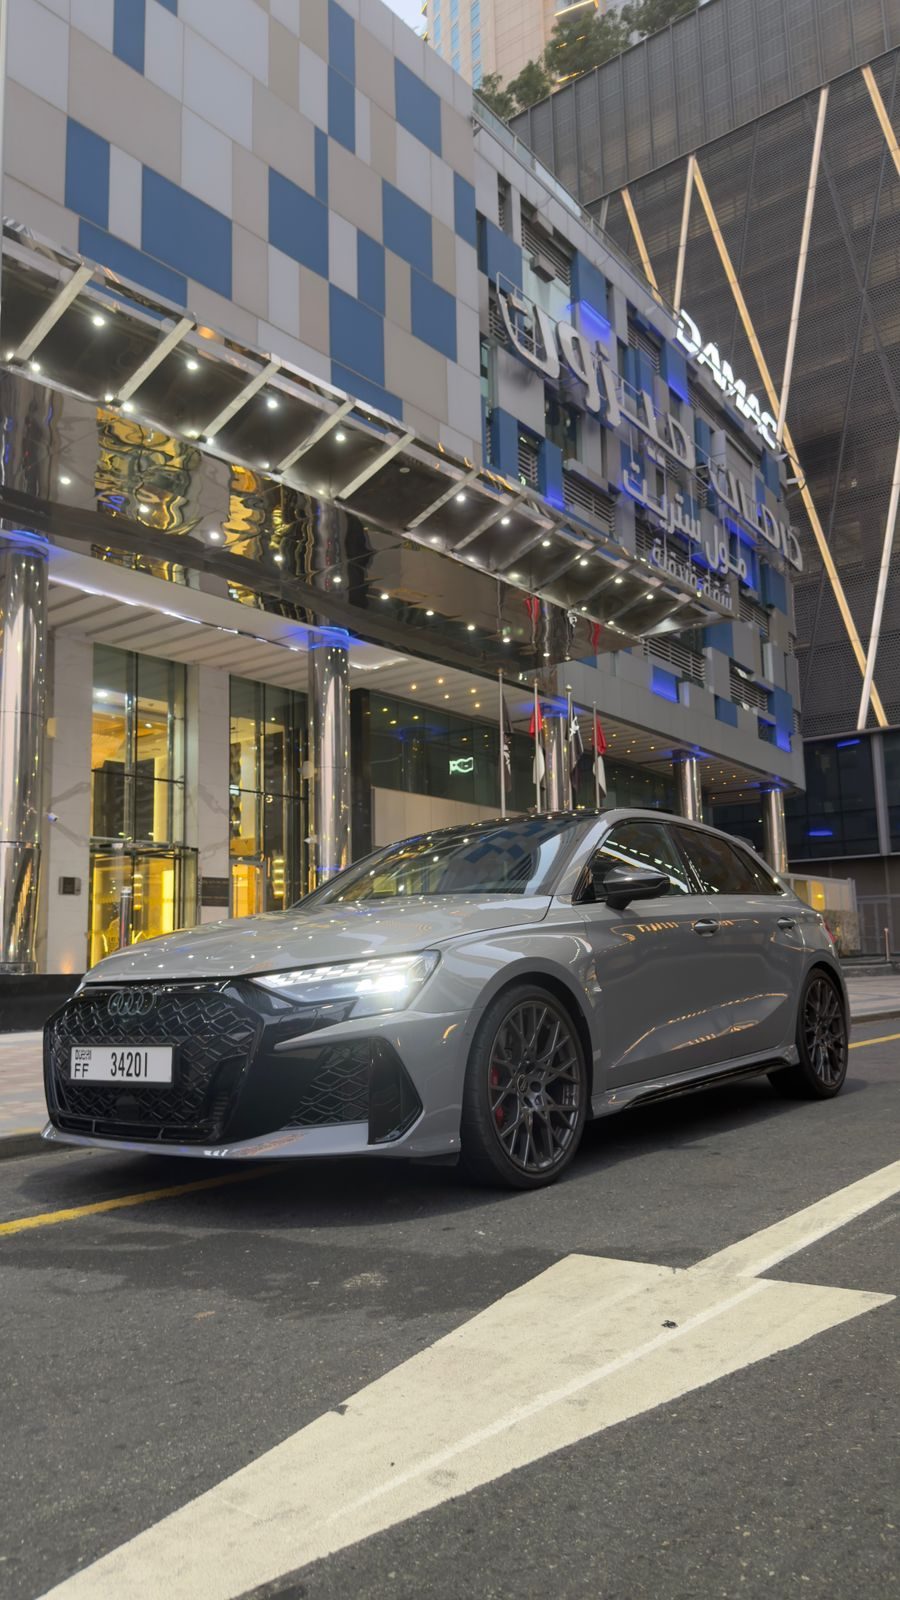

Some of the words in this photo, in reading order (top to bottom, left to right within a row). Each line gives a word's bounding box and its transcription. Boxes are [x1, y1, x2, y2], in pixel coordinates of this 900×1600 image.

[498, 292, 695, 469] ميزون
[676, 309, 778, 449] DAMAC
[623, 462, 701, 542] ستريت
[709, 462, 803, 571] داماك
[705, 524, 747, 580] مول
[74, 1063, 89, 1077] FF
[110, 1052, 148, 1077] 34201
